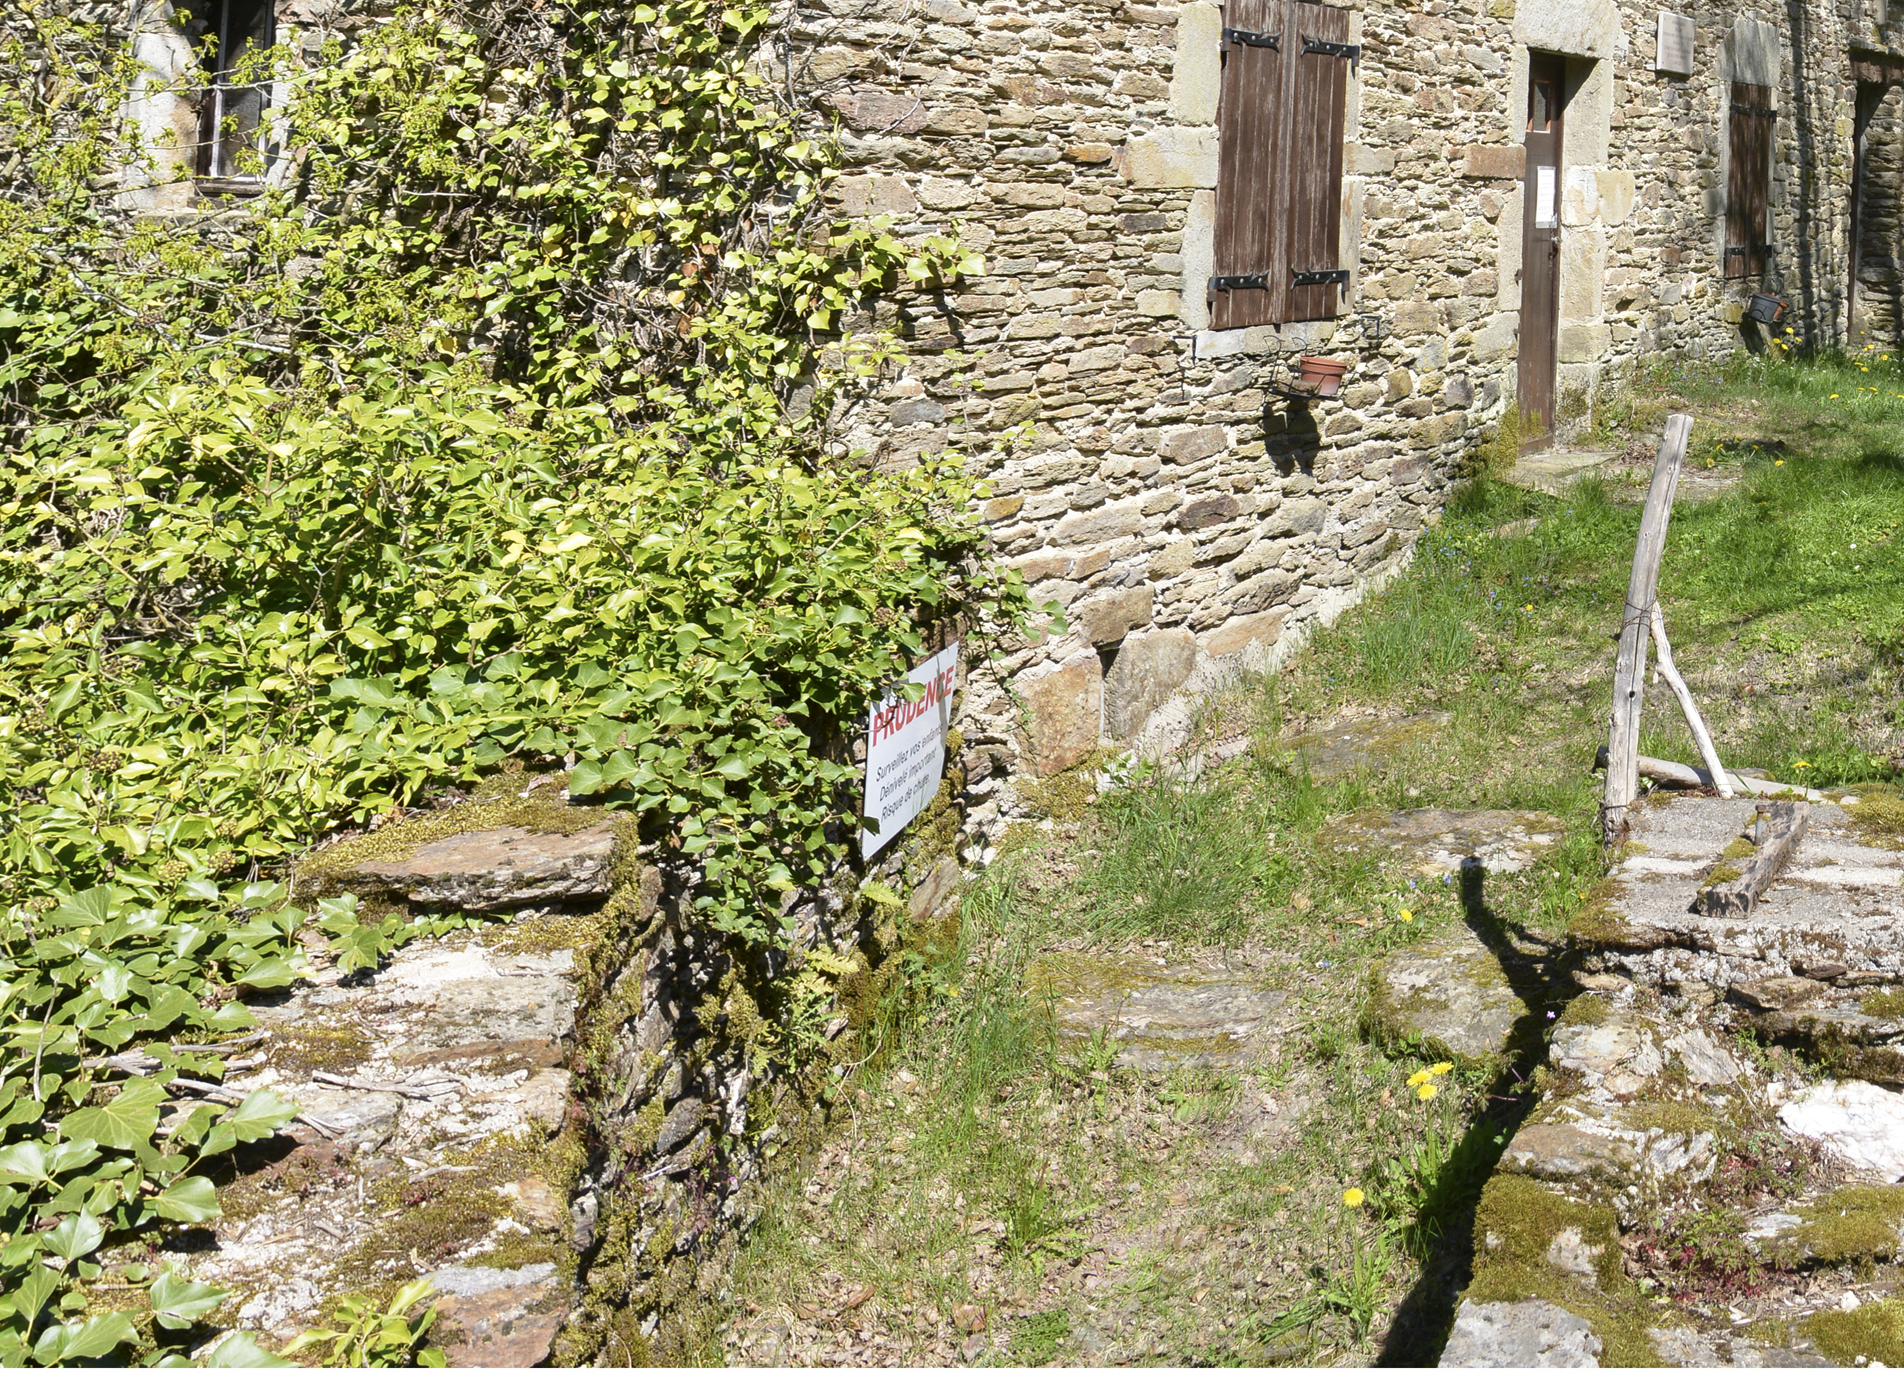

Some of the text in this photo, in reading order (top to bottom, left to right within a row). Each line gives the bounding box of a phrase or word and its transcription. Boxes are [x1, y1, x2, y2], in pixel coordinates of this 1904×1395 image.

[873, 665, 954, 747] PRUDENCE
[876, 749, 909, 782] Surveillez
[909, 741, 921, 759] vos
[879, 769, 907, 802] Dénivelé
[881, 795, 904, 823] Risque
[904, 786, 913, 801] de
